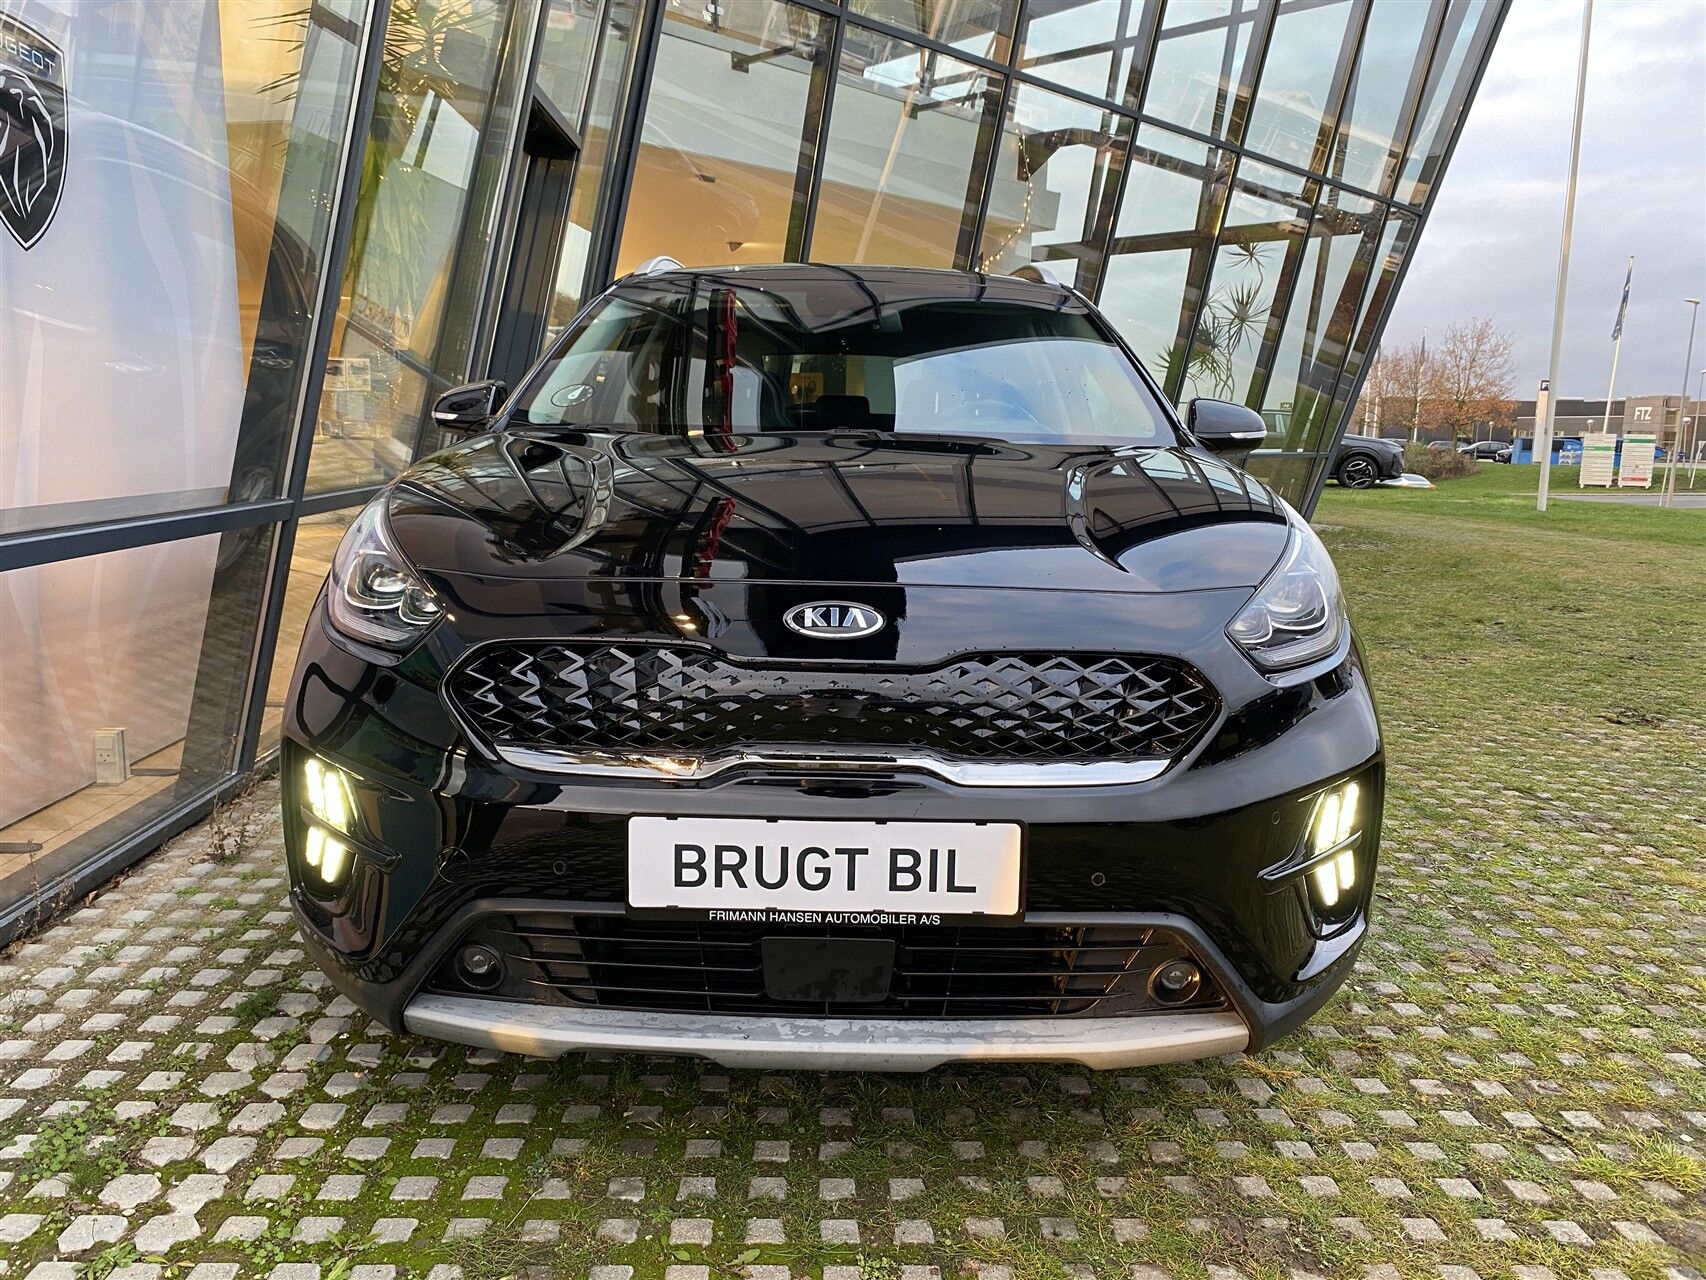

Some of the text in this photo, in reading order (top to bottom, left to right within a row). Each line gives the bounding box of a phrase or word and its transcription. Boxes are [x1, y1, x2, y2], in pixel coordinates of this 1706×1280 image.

[0, 33, 56, 75] GEOT
[1634, 406, 1652, 420] FTZ
[804, 607, 867, 628] KIA
[674, 844, 977, 893] BRUGT BIL
[709, 910, 941, 925] FRIMANN HANSEN AUTOMOBILER A/S
